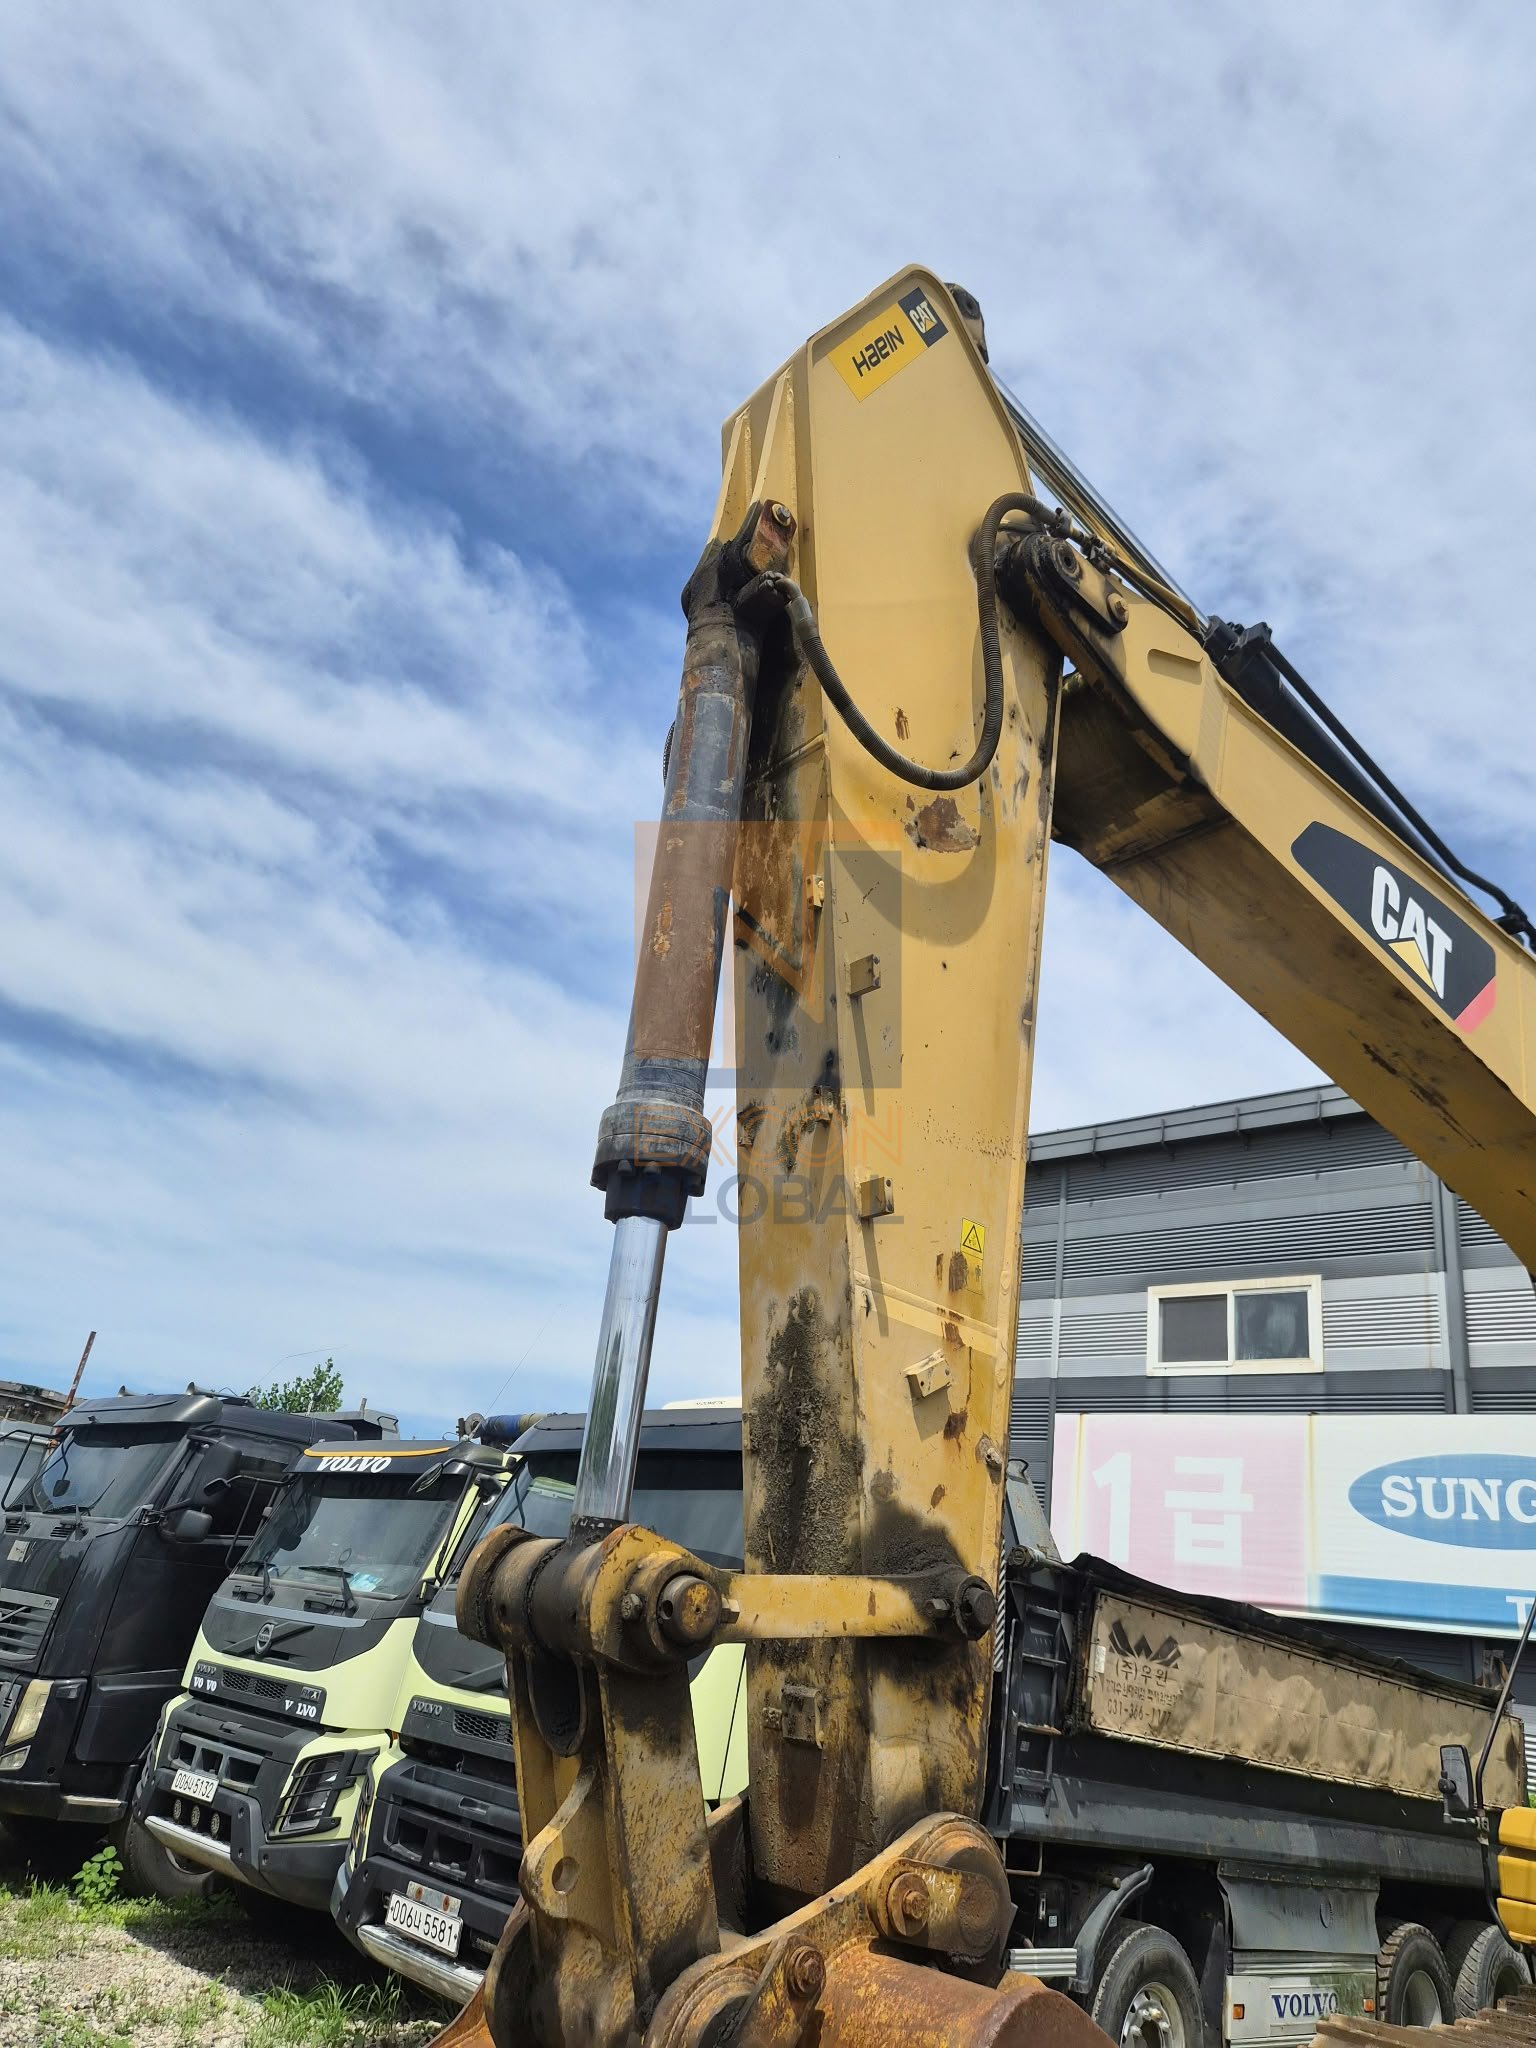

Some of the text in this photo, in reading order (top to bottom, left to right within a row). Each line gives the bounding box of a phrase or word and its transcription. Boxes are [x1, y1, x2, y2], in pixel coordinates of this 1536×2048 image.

[909, 301, 938, 334] CAT
[1371, 866, 1452, 1000] CAT
[316, 1456, 392, 1473] VOLVO
[1380, 1475, 1536, 1524] SUNG
[412, 1700, 442, 1716] VOLVO
[1271, 1993, 1338, 2019] VOLVO
